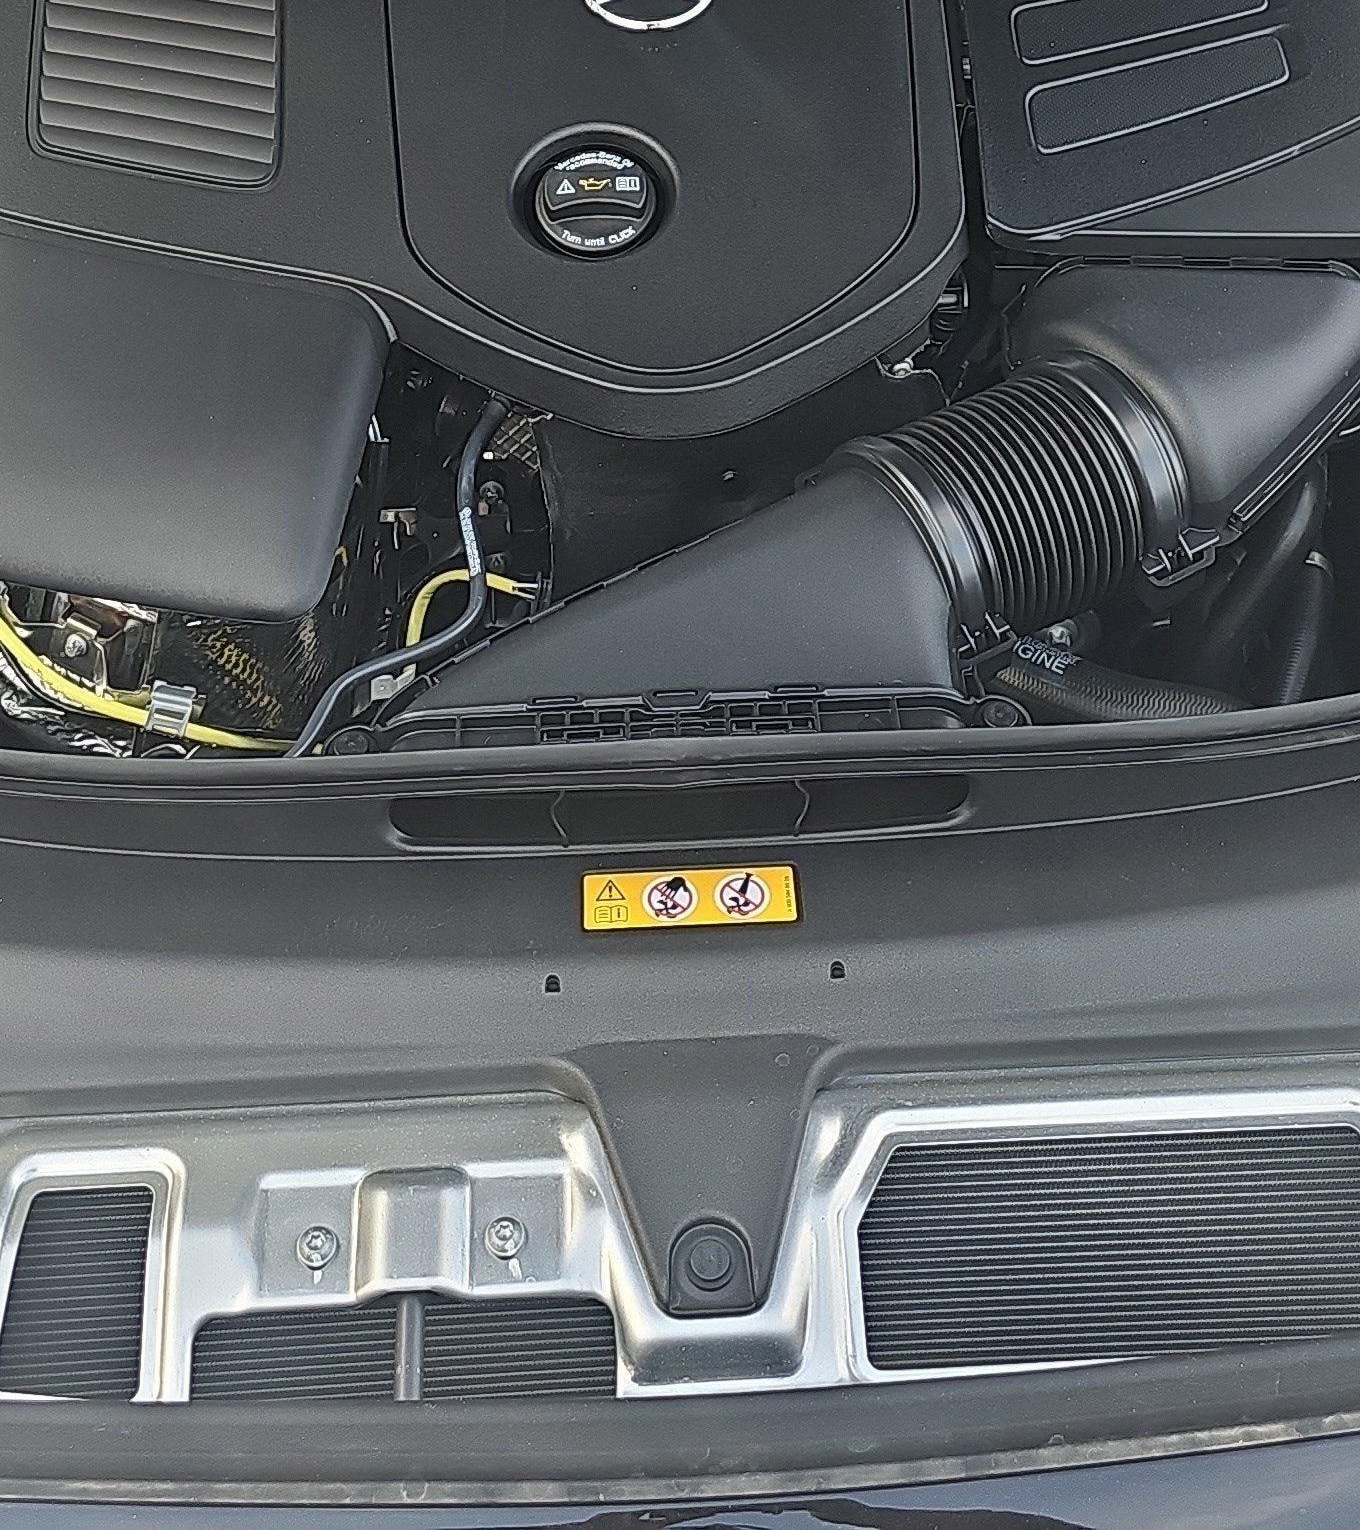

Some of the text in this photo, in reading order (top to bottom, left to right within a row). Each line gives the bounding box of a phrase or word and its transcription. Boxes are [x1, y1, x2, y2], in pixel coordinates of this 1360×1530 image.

[554, 151, 621, 170] Mercedes-Benz
[566, 158, 624, 170] recommended
[562, 226, 636, 246] Turn until CLICK
